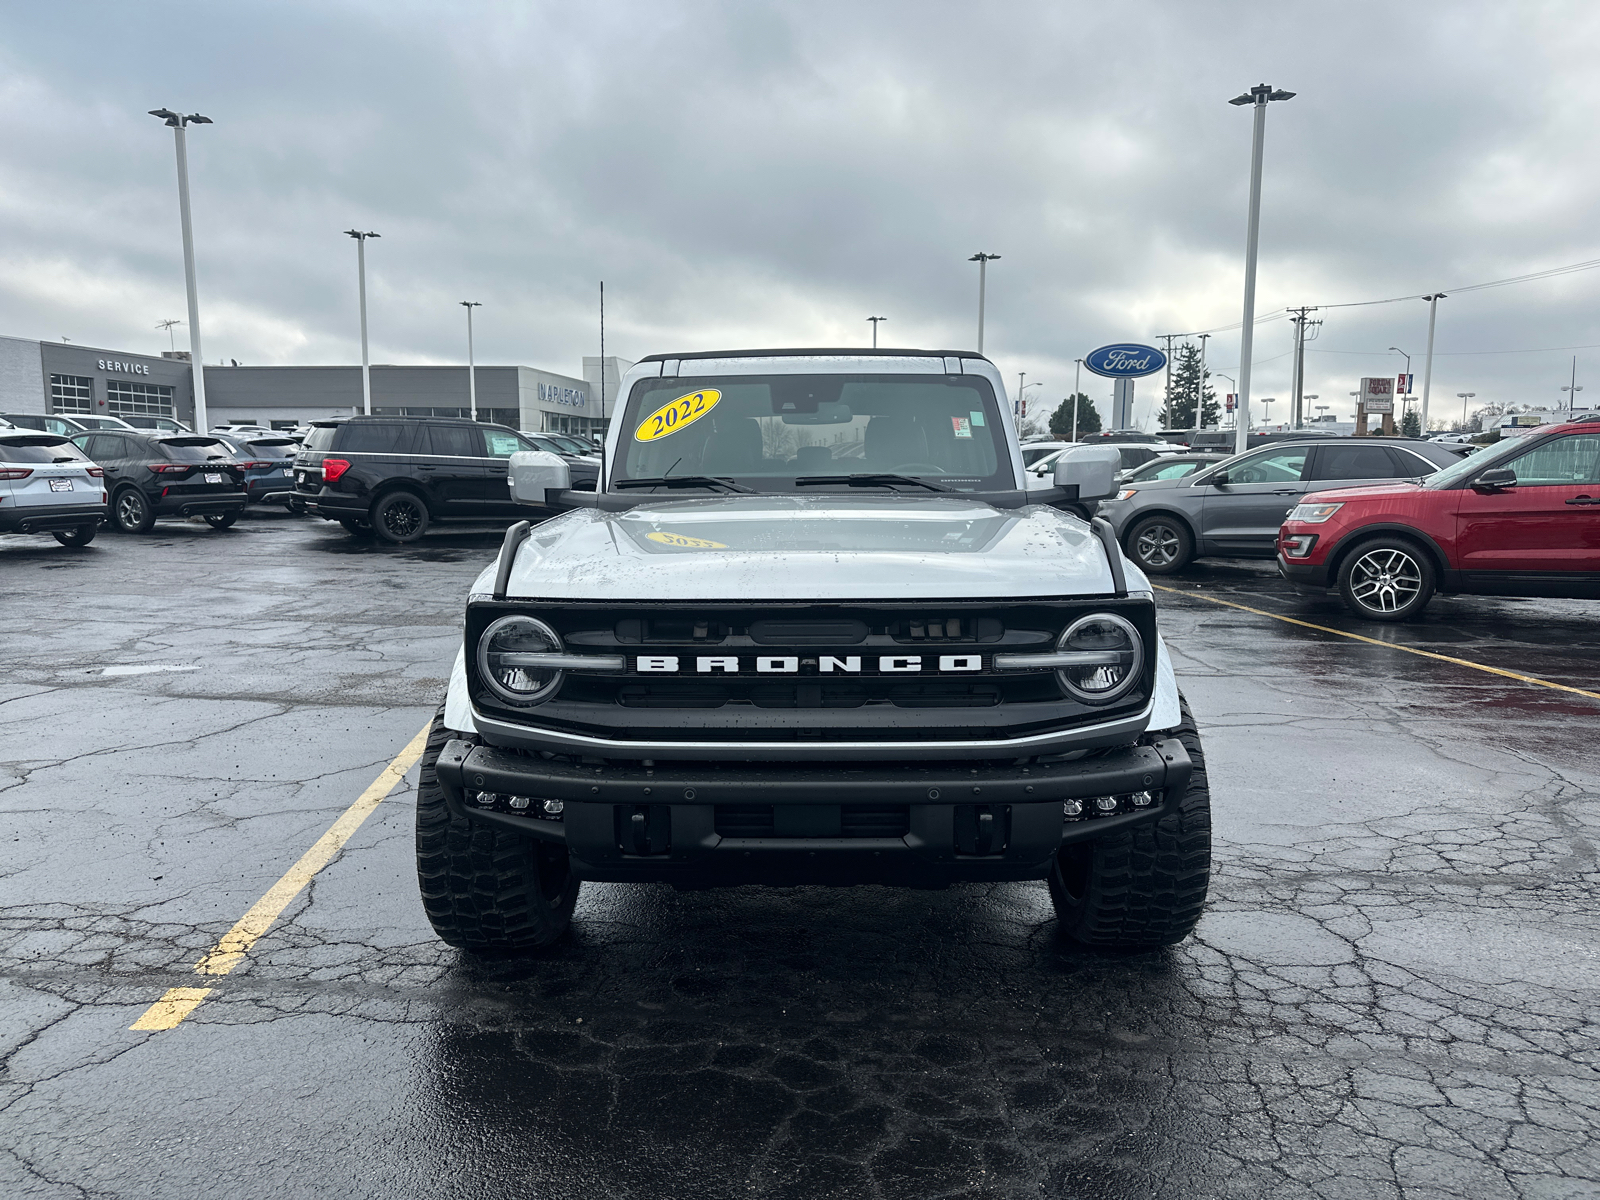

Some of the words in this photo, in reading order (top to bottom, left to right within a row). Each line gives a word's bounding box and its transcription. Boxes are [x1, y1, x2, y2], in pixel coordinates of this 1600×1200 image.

[98, 359, 149, 375] SERVICE
[1103, 350, 1151, 370] Ford
[538, 382, 585, 407] NAPLETON
[652, 394, 705, 437] 2022
[636, 655, 982, 673] BRONCO
